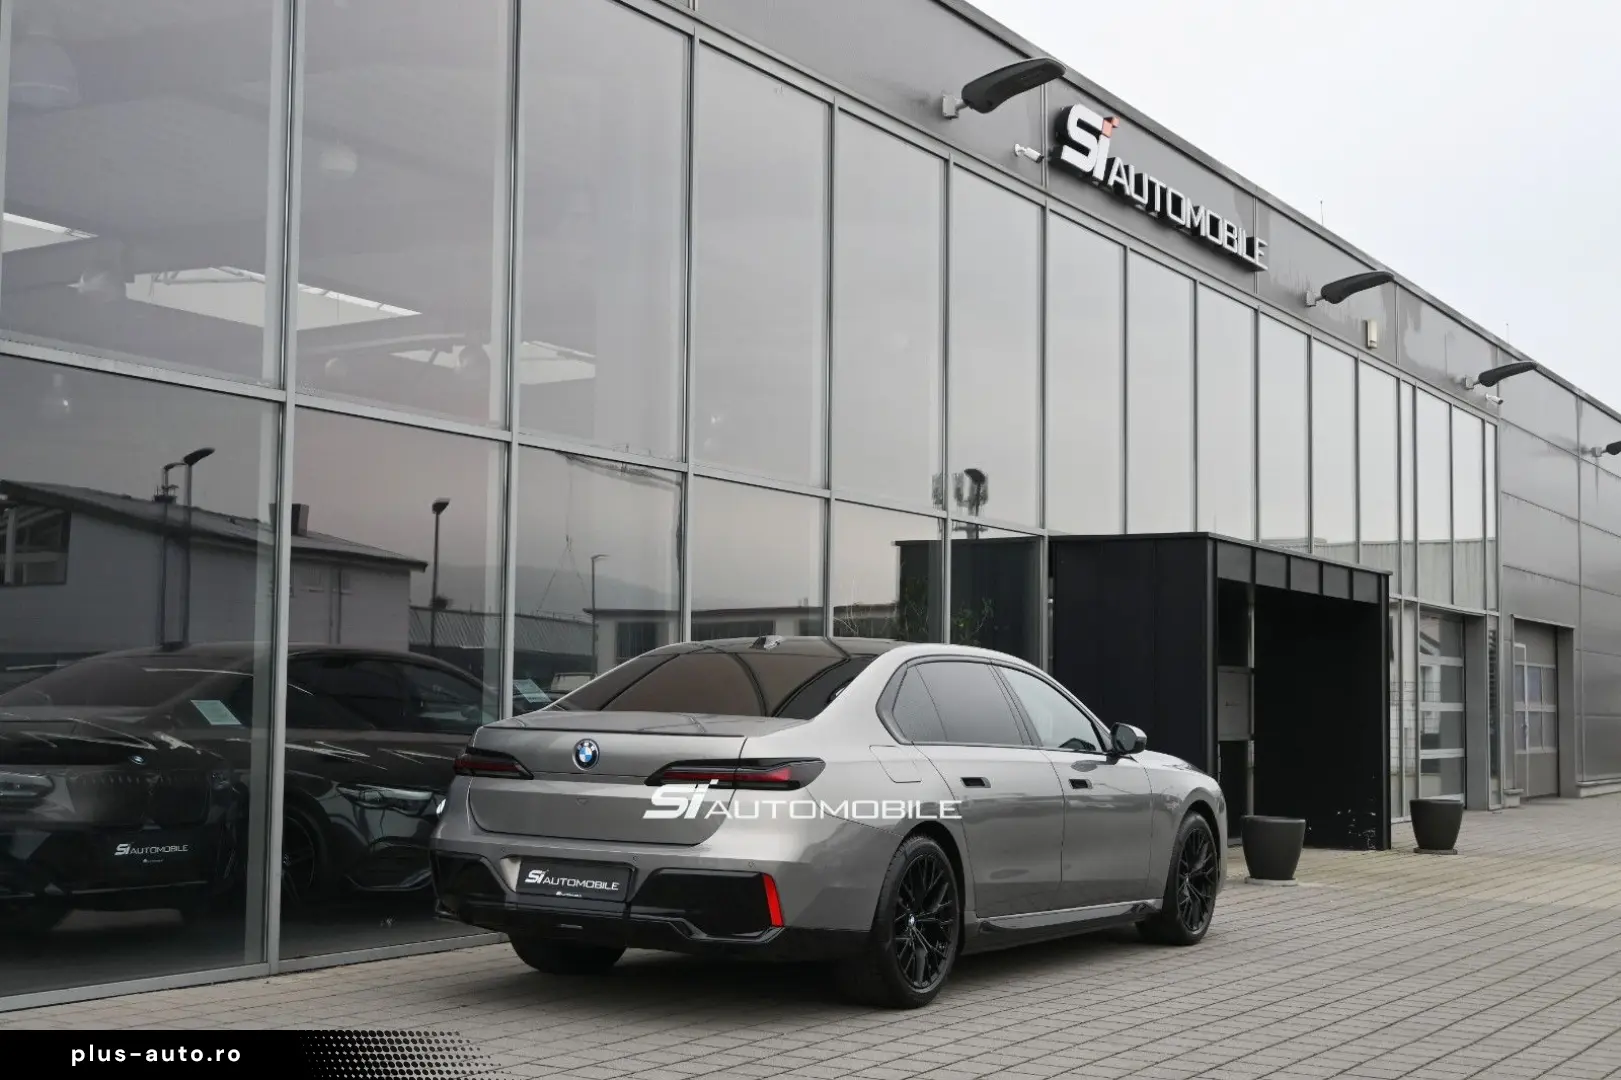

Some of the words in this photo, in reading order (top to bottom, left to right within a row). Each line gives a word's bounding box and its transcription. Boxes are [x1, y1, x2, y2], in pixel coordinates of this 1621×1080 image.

[1107, 156, 1269, 272] AUTOMOBILE
[130, 844, 189, 855] AUTOMOBILE
[542, 877, 620, 891] AUTOMOBILE
